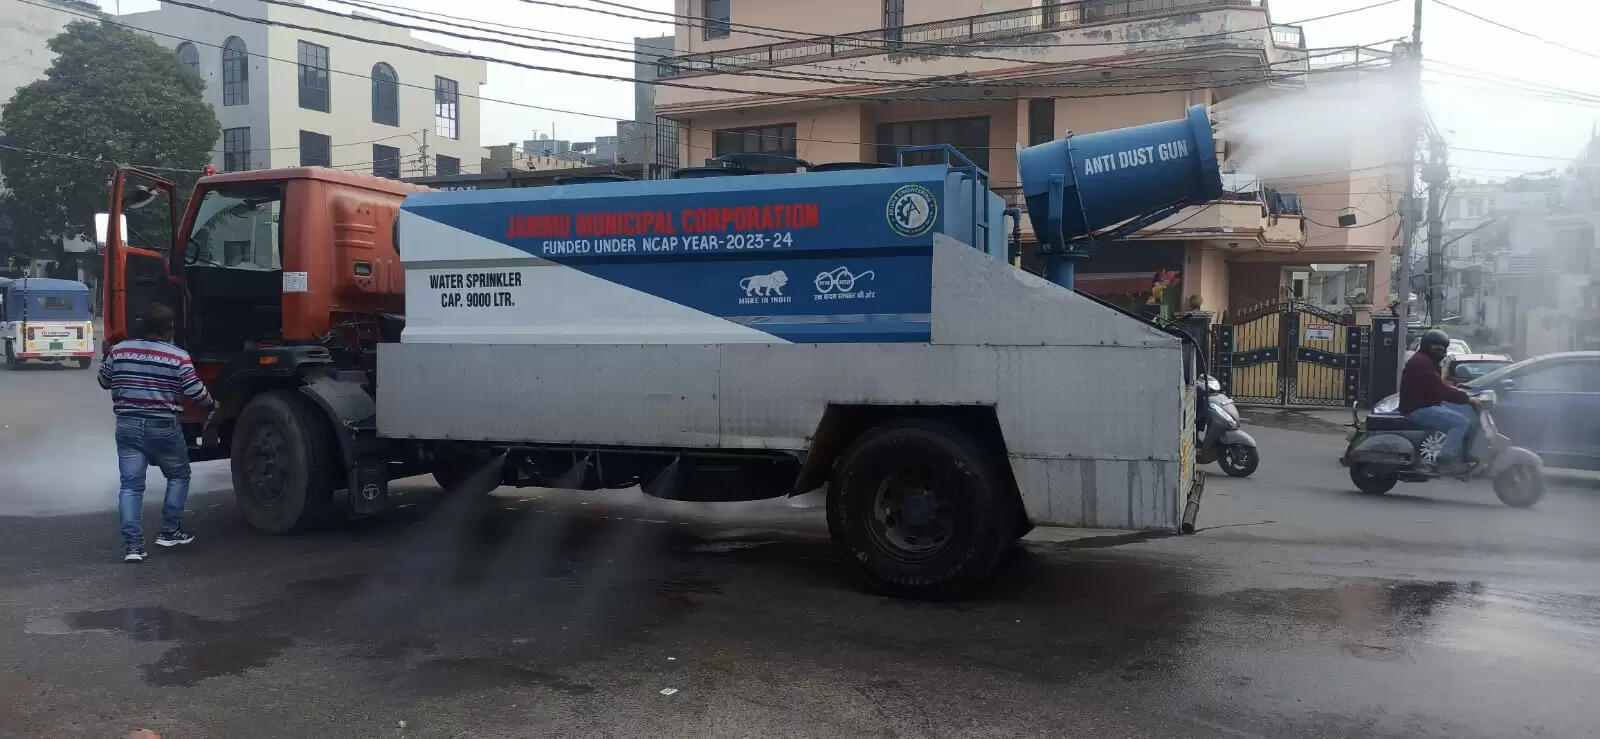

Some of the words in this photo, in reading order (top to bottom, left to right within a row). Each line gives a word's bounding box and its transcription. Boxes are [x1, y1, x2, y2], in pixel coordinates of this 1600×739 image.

[1085, 153, 1116, 175] ANTI
[1119, 145, 1154, 169] DUST
[1158, 140, 1189, 162] GUN
[506, 213, 571, 238] JAMMU
[575, 209, 677, 237] MUNICIPAL
[681, 202, 820, 233] CORPORATION
[542, 239, 591, 255] FUNDED
[594, 238, 637, 254] UNDER
[642, 236, 679, 252] NCAP
[429, 273, 464, 289] WATER
[466, 272, 522, 289] SPRINKLER
[441, 293, 463, 307] CAP.
[466, 292, 491, 307] 9000
[493, 292, 516, 307] LTR.
[738, 297, 760, 305] MAKE
[761, 296, 769, 304] IN
[770, 296, 792, 304] INDIA
